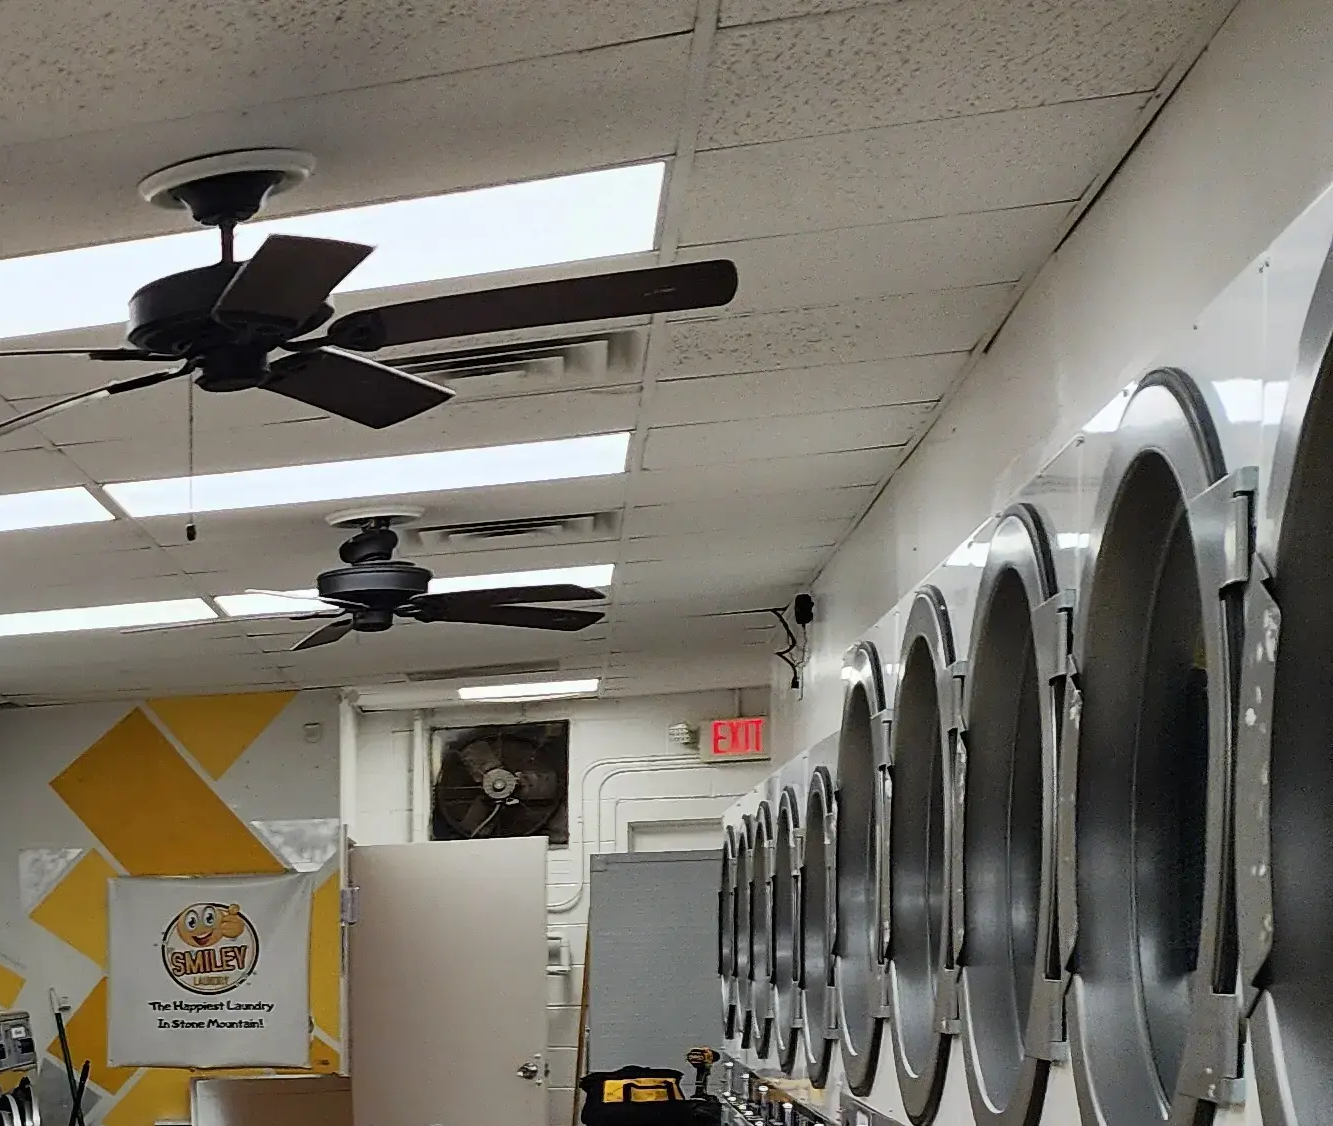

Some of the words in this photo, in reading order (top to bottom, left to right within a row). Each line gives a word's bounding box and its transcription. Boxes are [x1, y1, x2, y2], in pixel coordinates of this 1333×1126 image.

[712, 718, 763, 755] EXIT
[171, 945, 247, 977] SMILEY
[148, 1001, 172, 1011] The
[173, 1000, 225, 1013] Happiest
[226, 1000, 275, 1012] Laundry
[157, 1018, 170, 1028] In
[171, 1019, 205, 1028] Stone
[206, 1018, 265, 1028] Mountain!
